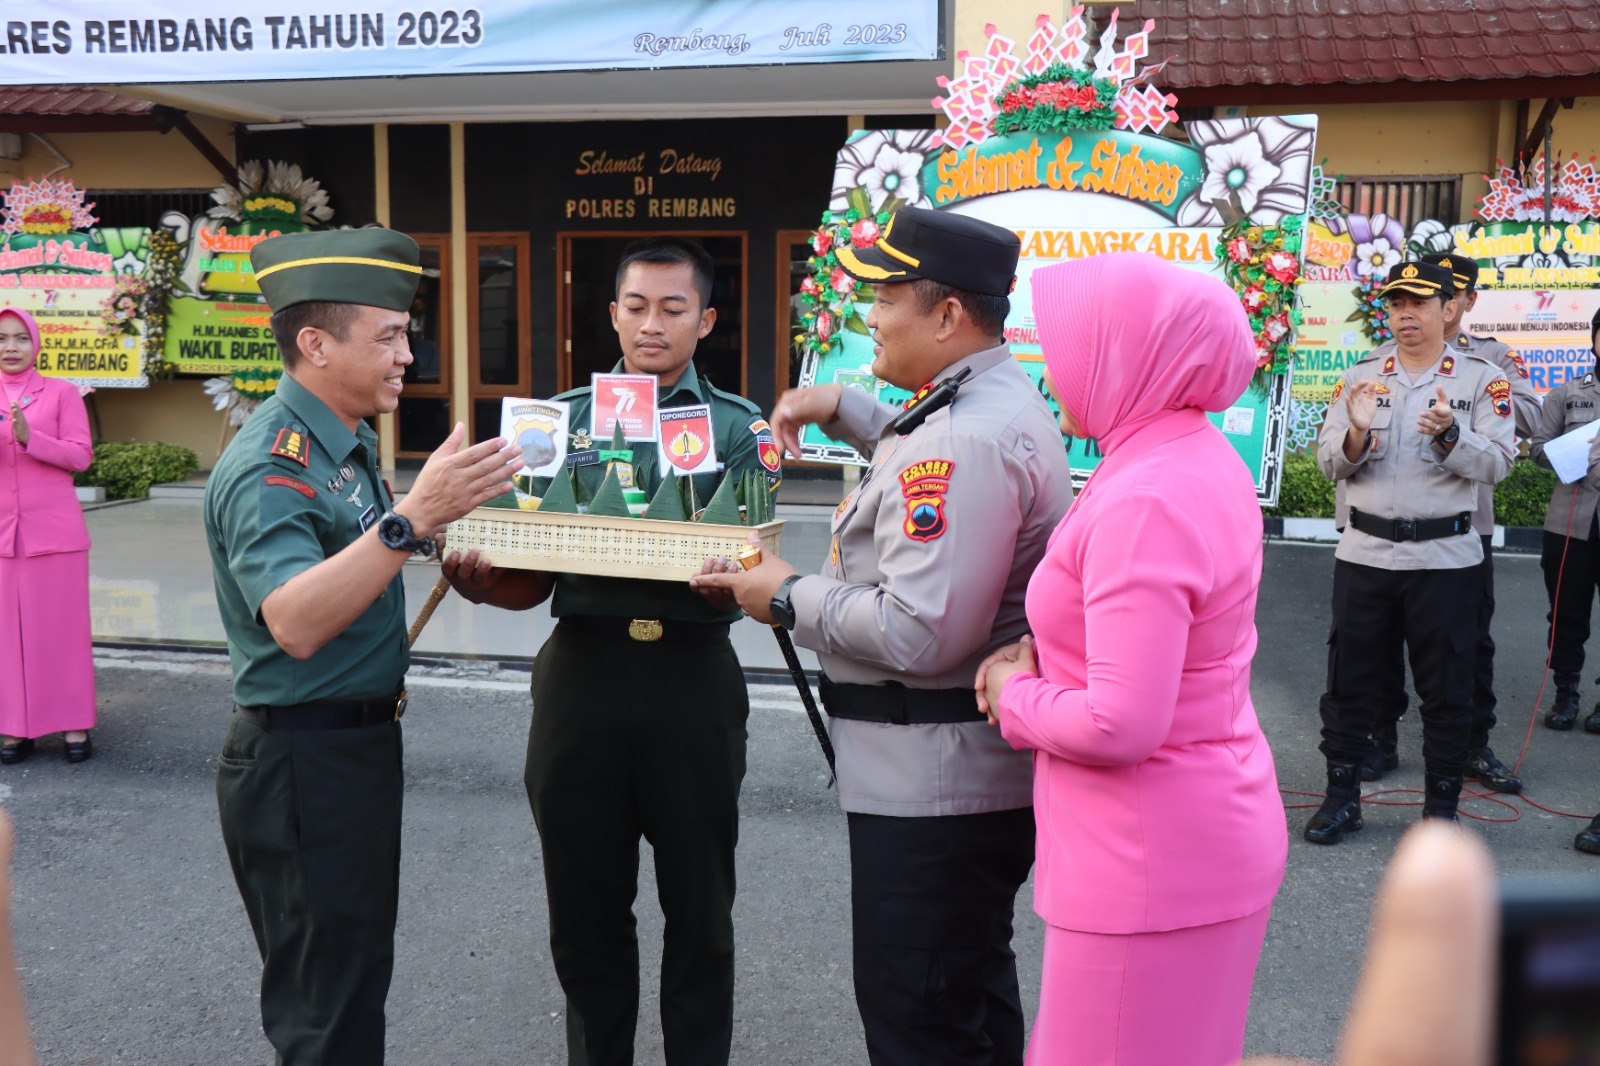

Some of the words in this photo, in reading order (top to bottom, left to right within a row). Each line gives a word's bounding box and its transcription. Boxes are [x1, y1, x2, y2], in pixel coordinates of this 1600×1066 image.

[85, 17, 253, 53] REMBANG
[265, 12, 384, 49] TAHUN
[397, 10, 482, 45] 2023
[634, 28, 750, 56] Rembang,
[779, 23, 832, 50] Juli
[843, 23, 907, 45] 2023
[575, 150, 645, 175] Selamat
[659, 149, 723, 181] Datang
[936, 137, 1043, 203] Selamat
[1046, 136, 1083, 191] &
[1082, 139, 1184, 206] Sukses
[634, 176, 653, 195] DI
[566, 199, 636, 218] POLRES
[649, 197, 736, 218] REMBANG
[1453, 226, 1536, 258] Selamat
[1469, 323, 1496, 332] PEMILU
[1496, 323, 1518, 332] DAMAI
[1520, 322, 1550, 332] MENUJU
[1551, 321, 1591, 331] INDONESIA
[179, 340, 226, 360] WAKIL
[56, 352, 129, 372] REMBANG
[1529, 366, 1596, 389] REM
[1428, 398, 1471, 411] PLRI
[661, 409, 707, 421] DIPONEGORO
[902, 461, 949, 478] POLRES
